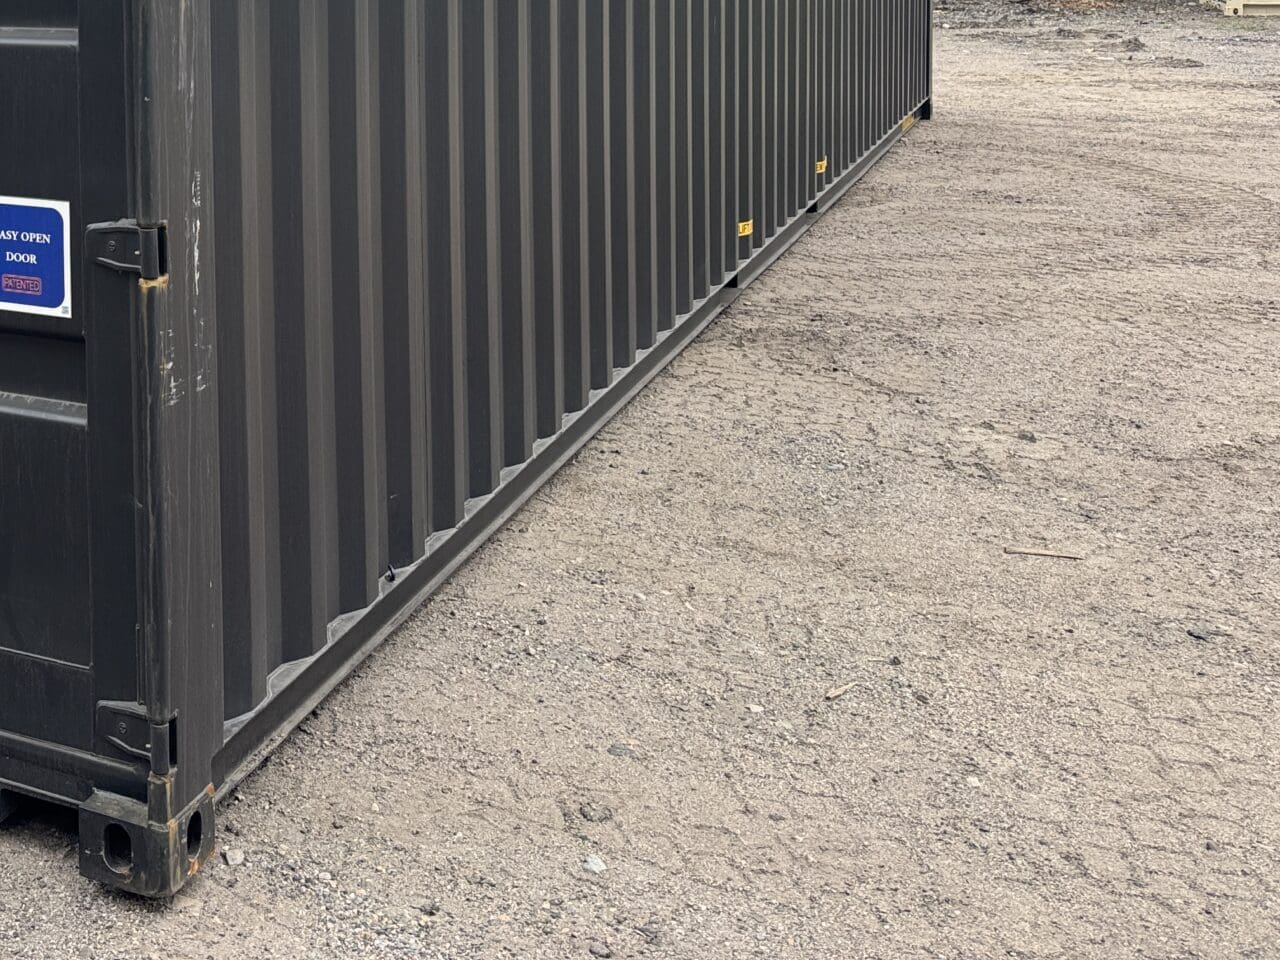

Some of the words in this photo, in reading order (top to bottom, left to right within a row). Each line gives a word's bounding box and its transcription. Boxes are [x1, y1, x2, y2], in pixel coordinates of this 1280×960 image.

[21, 232, 51, 244] OPEN
[5, 251, 38, 264] DOOR
[3, 277, 40, 292] PATENTED
